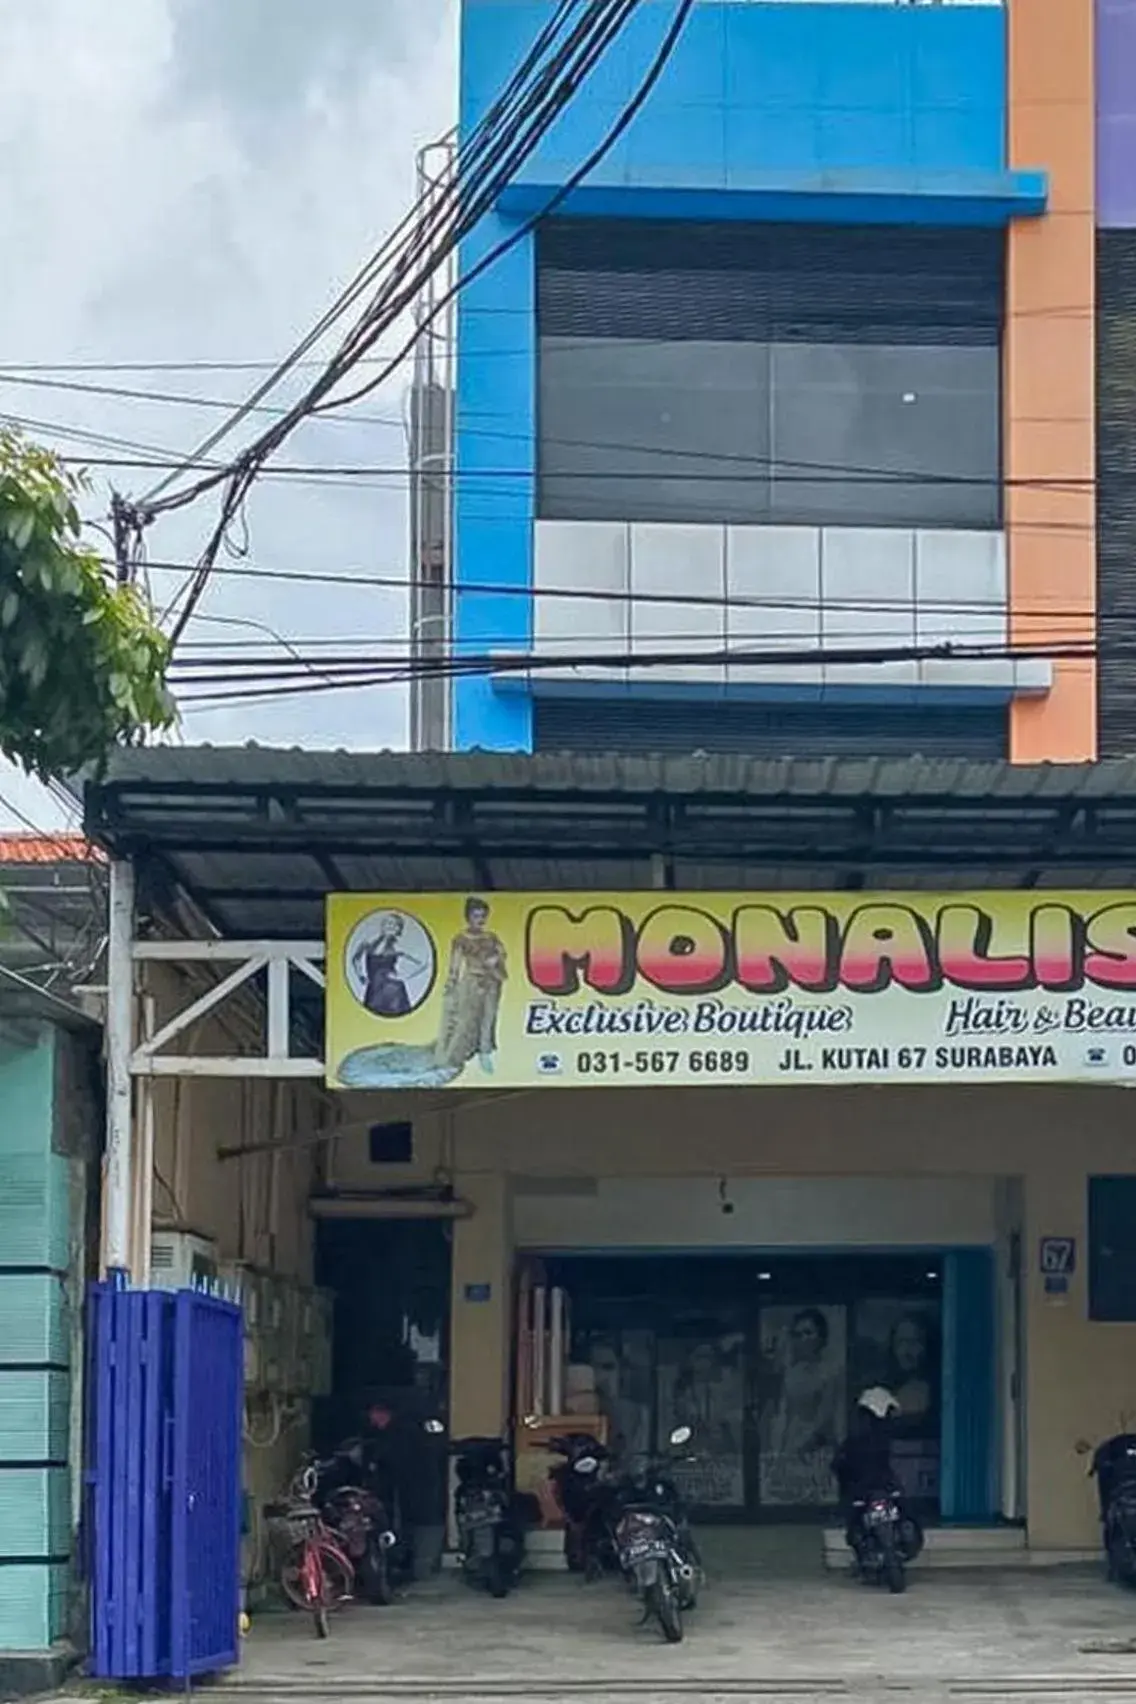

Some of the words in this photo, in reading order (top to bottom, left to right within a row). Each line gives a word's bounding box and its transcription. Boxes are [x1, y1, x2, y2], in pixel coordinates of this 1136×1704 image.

[526, 1001, 689, 1035] Exclusive
[694, 999, 852, 1038] Boutique
[945, 997, 1029, 1035] Hair
[1032, 1005, 1059, 1034] &
[576, 1051, 680, 1074] 031-567
[688, 1050, 749, 1073] 6689
[778, 1048, 813, 1071] JL.
[821, 1047, 889, 1070] KUTAI
[898, 1047, 927, 1069] 67
[935, 1045, 1058, 1068] SURABAYA
[1042, 1239, 1072, 1270] 67
